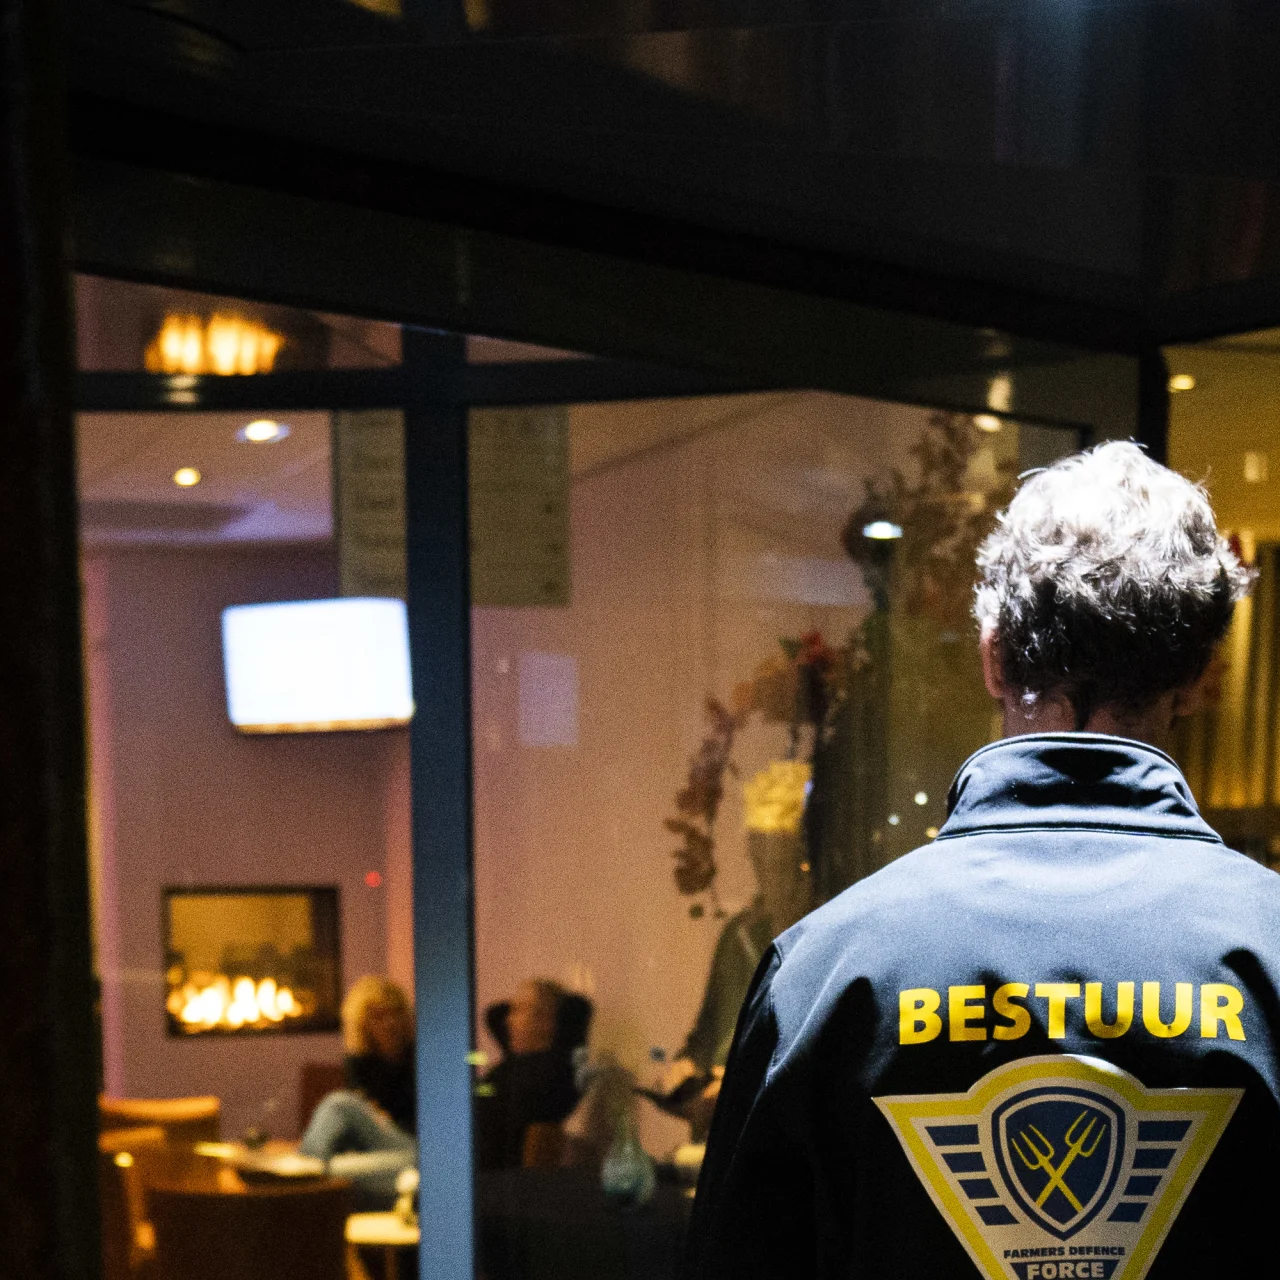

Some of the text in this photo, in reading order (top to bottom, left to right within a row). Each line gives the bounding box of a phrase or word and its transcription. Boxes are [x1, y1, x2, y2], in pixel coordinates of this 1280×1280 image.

[898, 980, 1246, 1046] BESTUUR
[1003, 1246, 1125, 1259] FARMERS DEFENCE
[1026, 1261, 1105, 1280] FORCE
